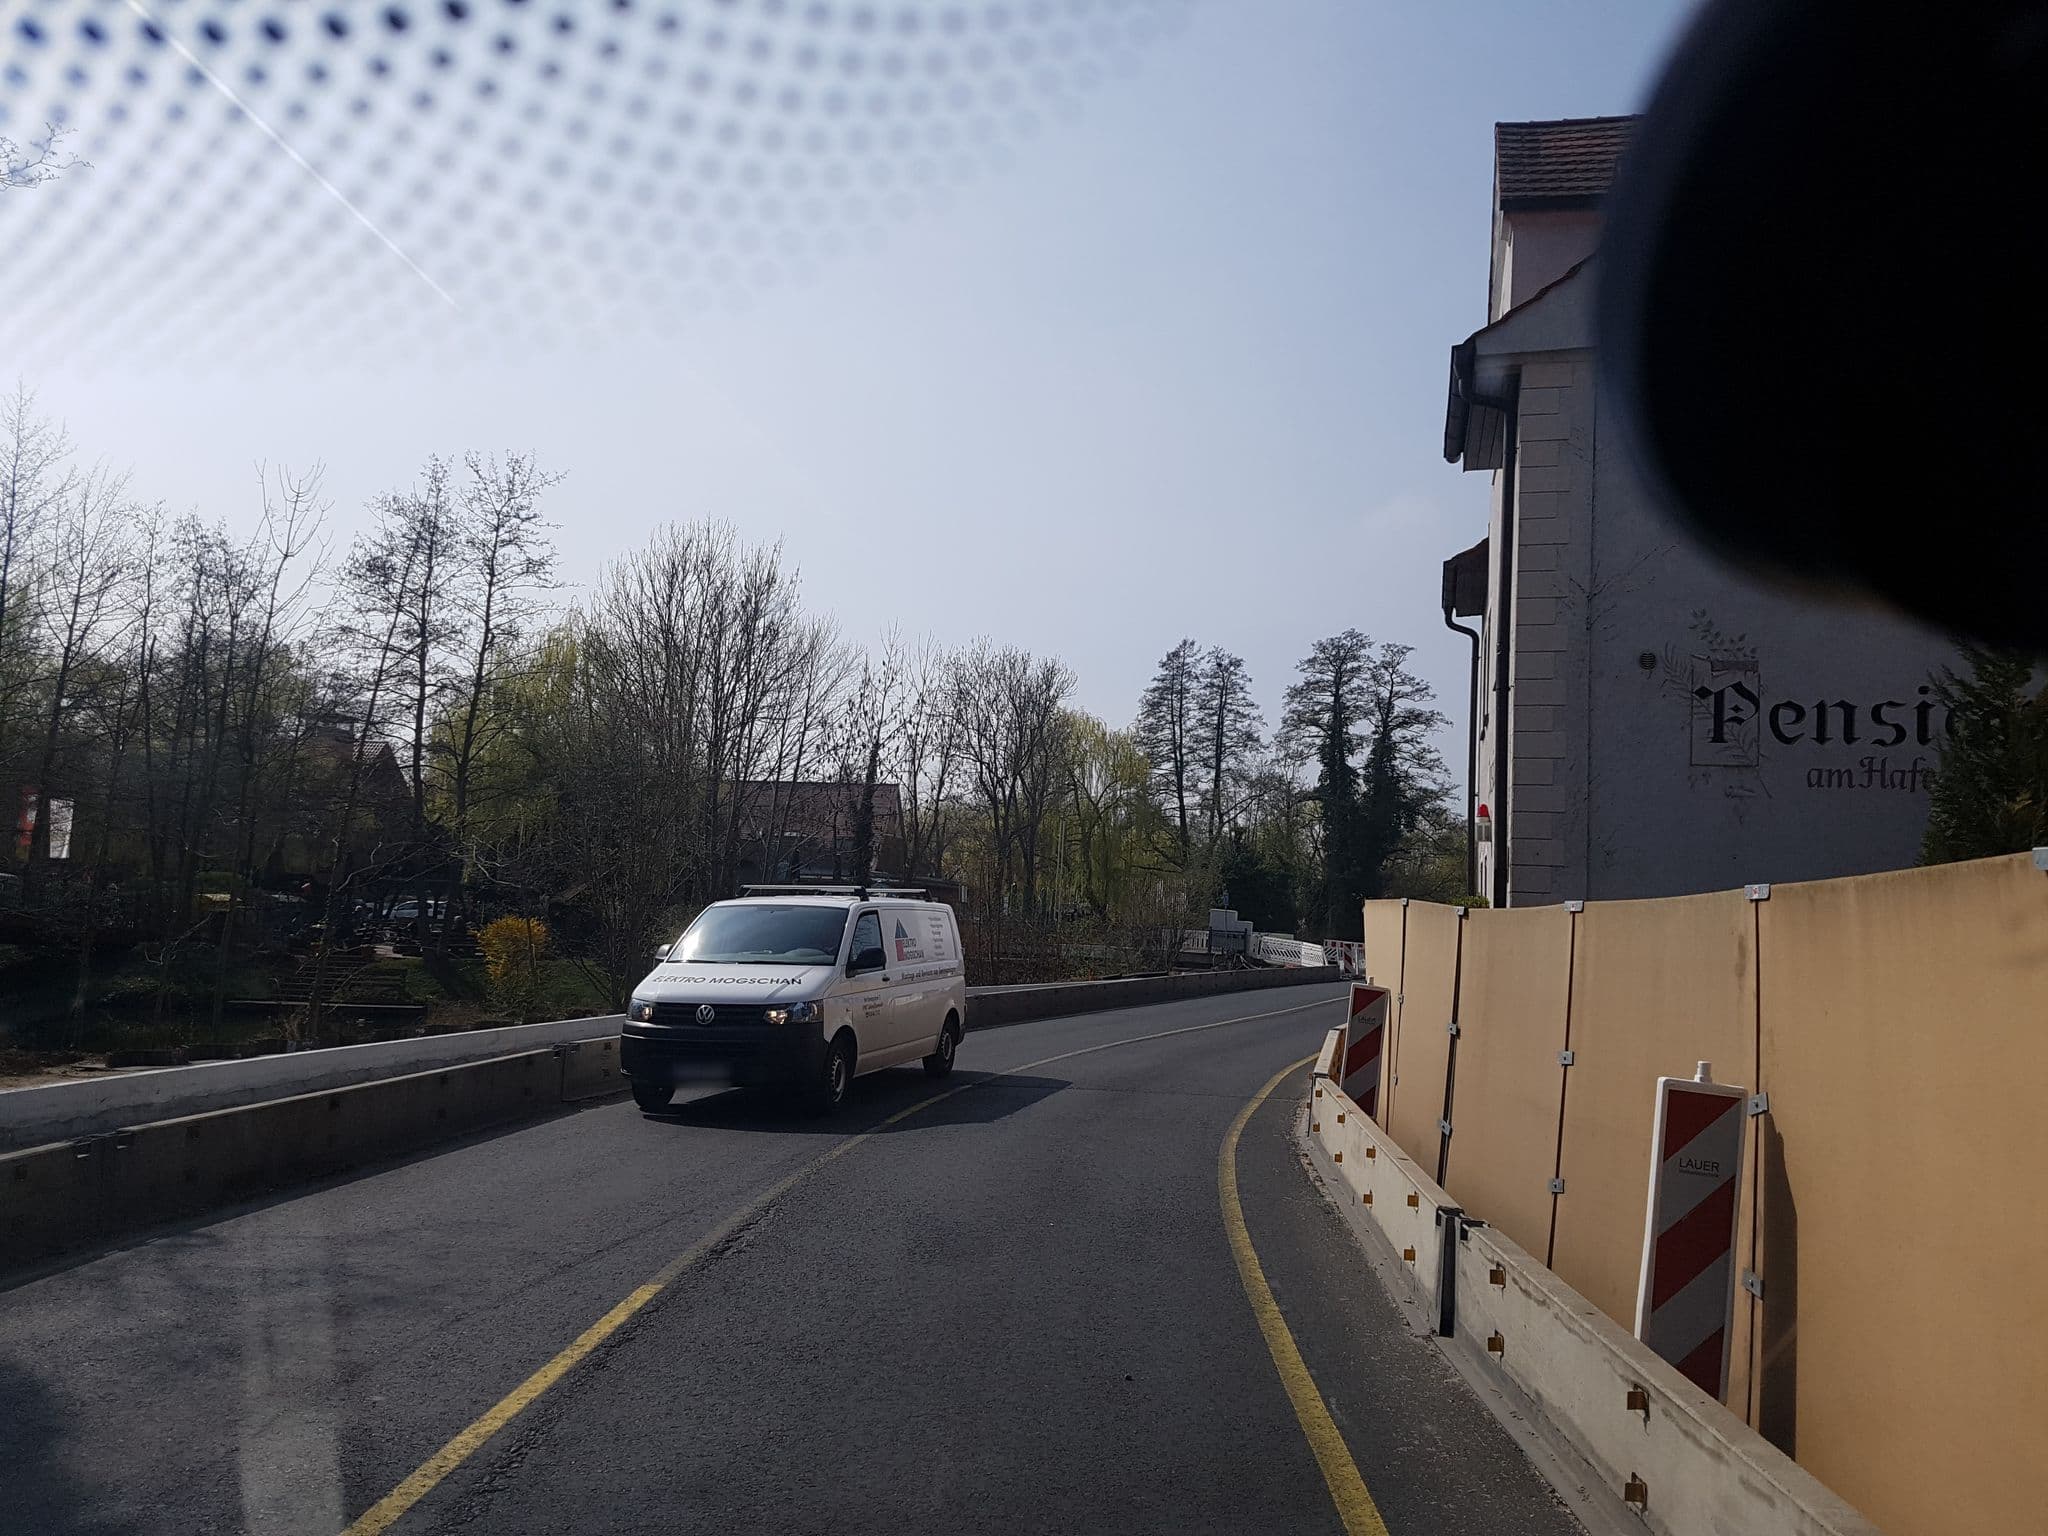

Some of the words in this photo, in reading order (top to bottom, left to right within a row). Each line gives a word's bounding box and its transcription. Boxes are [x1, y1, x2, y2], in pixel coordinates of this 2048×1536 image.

[1806, 766, 1856, 790] am
[708, 977, 802, 985] MOGSCHAN
[1679, 1158, 1720, 1172] LAUER
